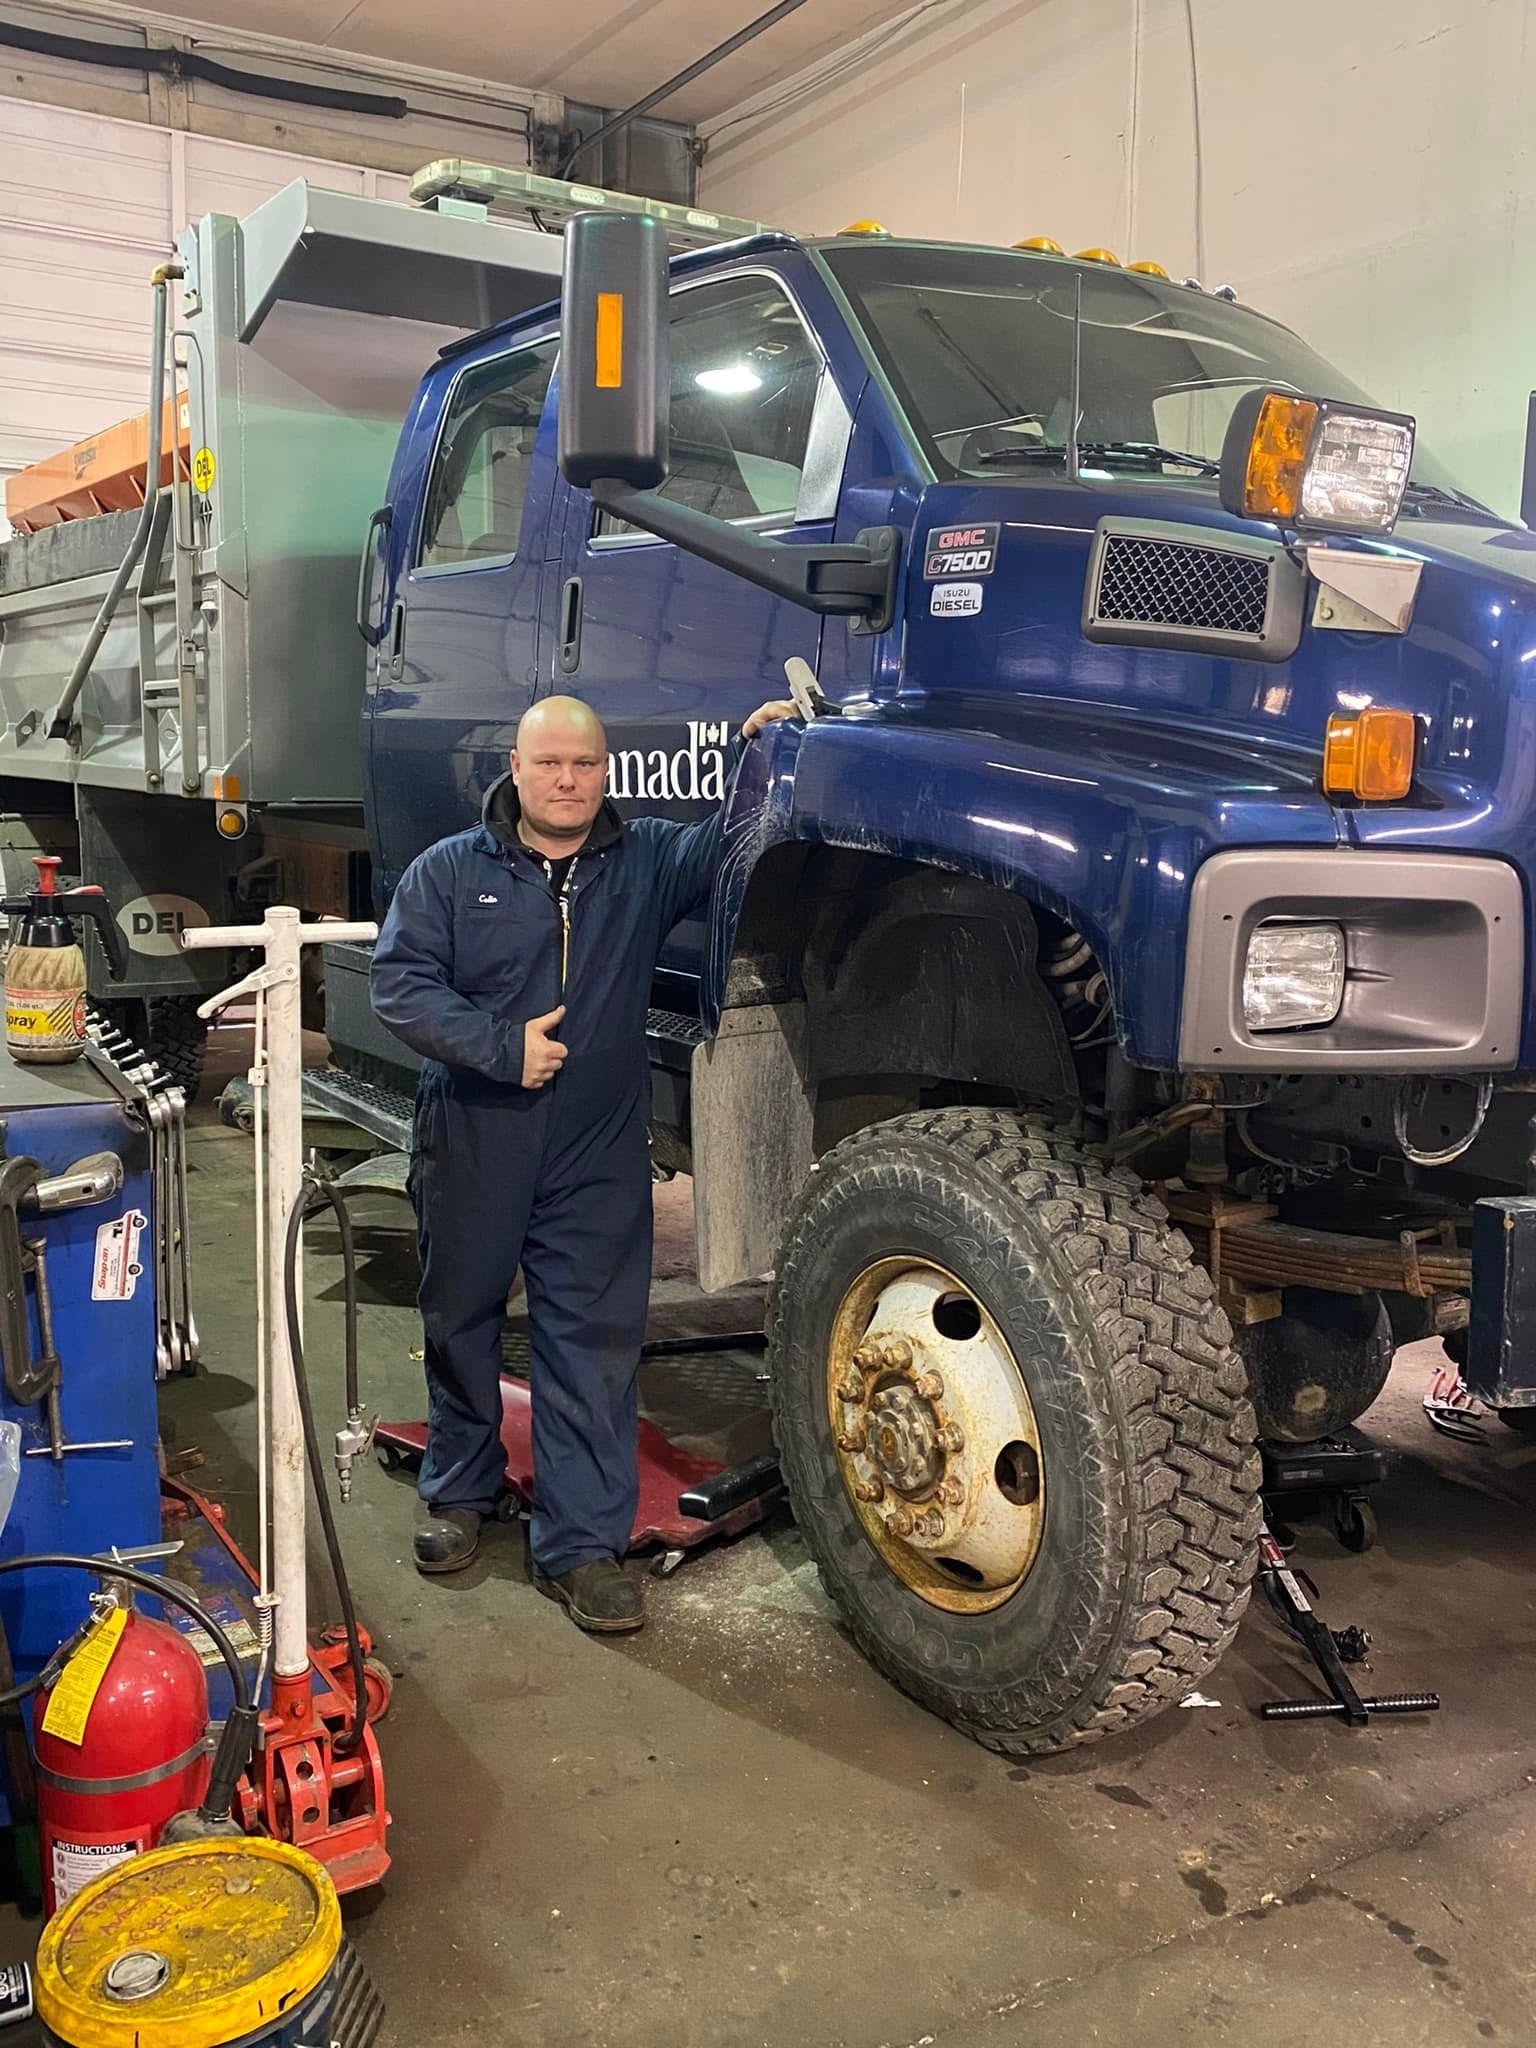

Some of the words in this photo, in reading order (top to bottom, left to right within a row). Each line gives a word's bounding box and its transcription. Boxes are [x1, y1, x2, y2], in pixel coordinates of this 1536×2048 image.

[196, 456, 212, 478] DEL
[939, 529, 986, 548] GMC
[928, 550, 991, 574] C7500
[943, 589, 970, 598] ISUZU
[932, 600, 979, 611] DIESEL
[604, 721, 725, 800] anada
[6, 1011, 36, 1030] pray
[98, 1247, 109, 1290] Snap-on
[56, 1840, 128, 1855] INSTRUCTIONS
